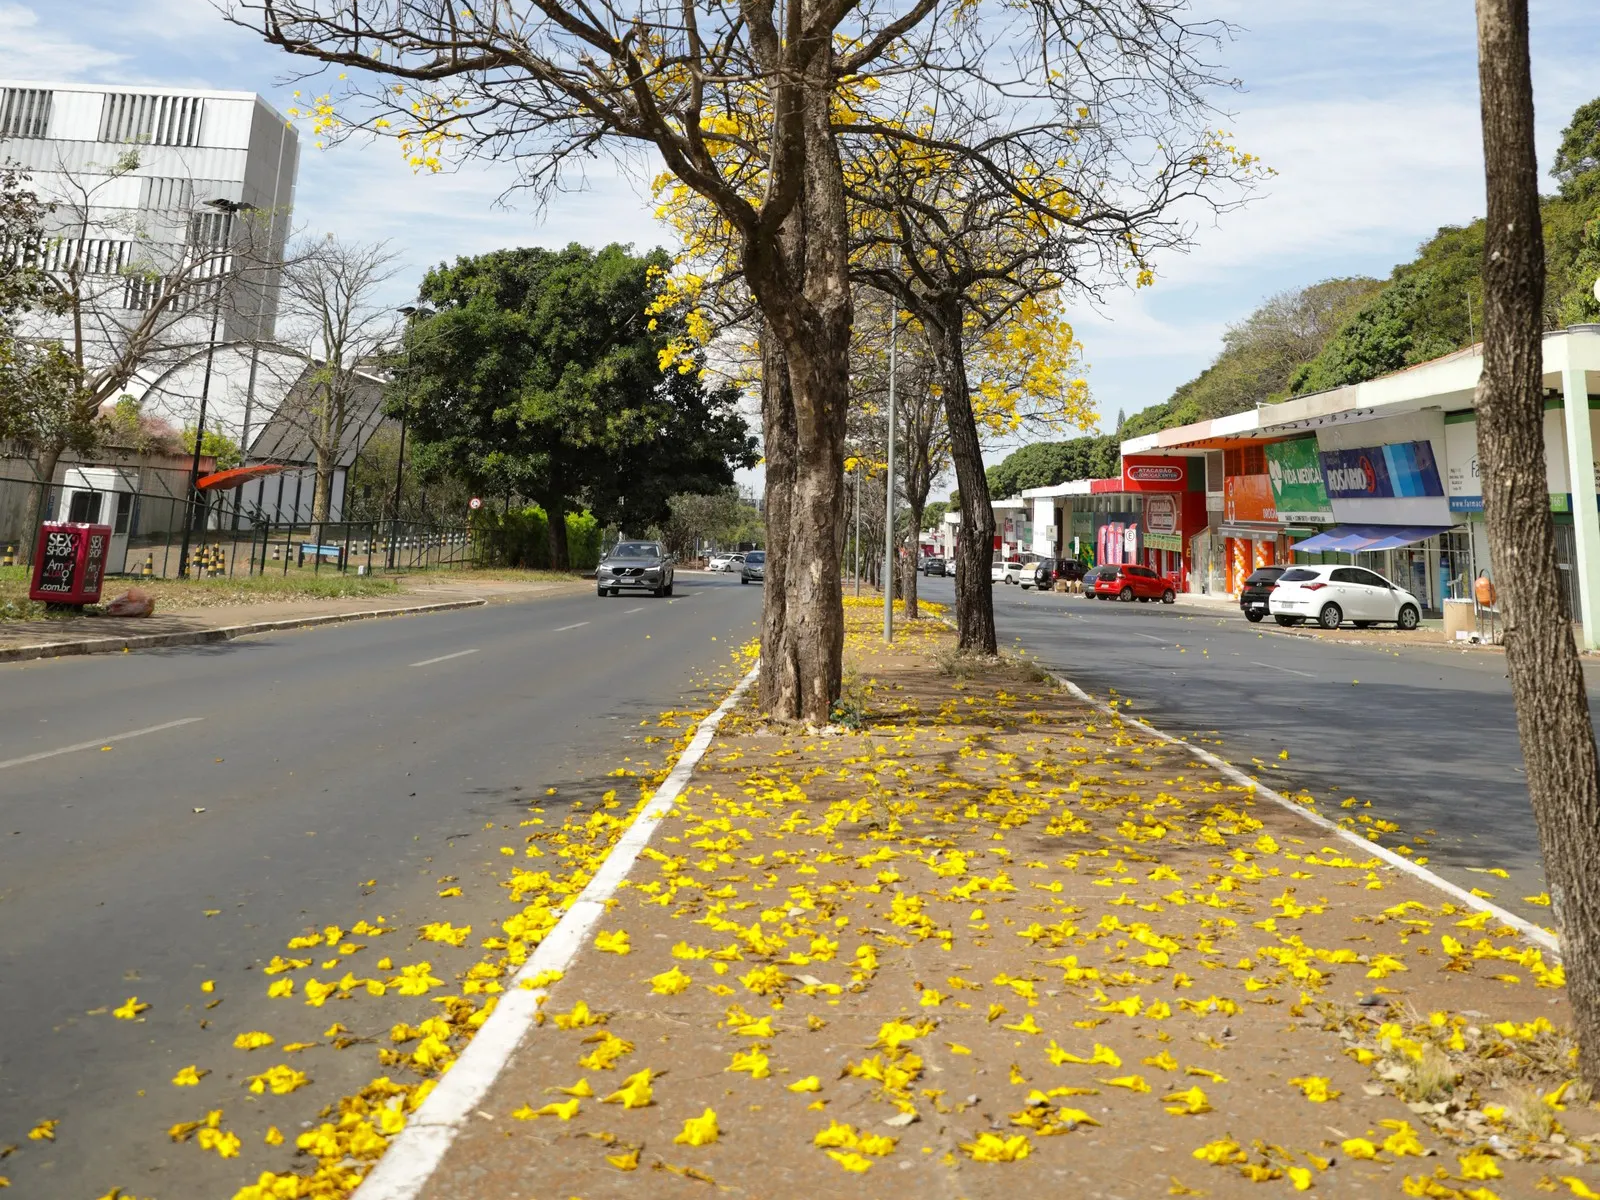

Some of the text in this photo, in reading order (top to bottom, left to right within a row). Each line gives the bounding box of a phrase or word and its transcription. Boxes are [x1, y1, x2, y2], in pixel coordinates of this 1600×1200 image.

[1282, 467, 1324, 484] VIDA MEDICAL
[1327, 463, 1367, 490] ROSÁRIO
[48, 532, 73, 547] SEX
[91, 535, 103, 549] SEX
[46, 545, 72, 557] SHOP
[89, 548, 101, 558] SHOP
[40, 583, 70, 592] .com.br
